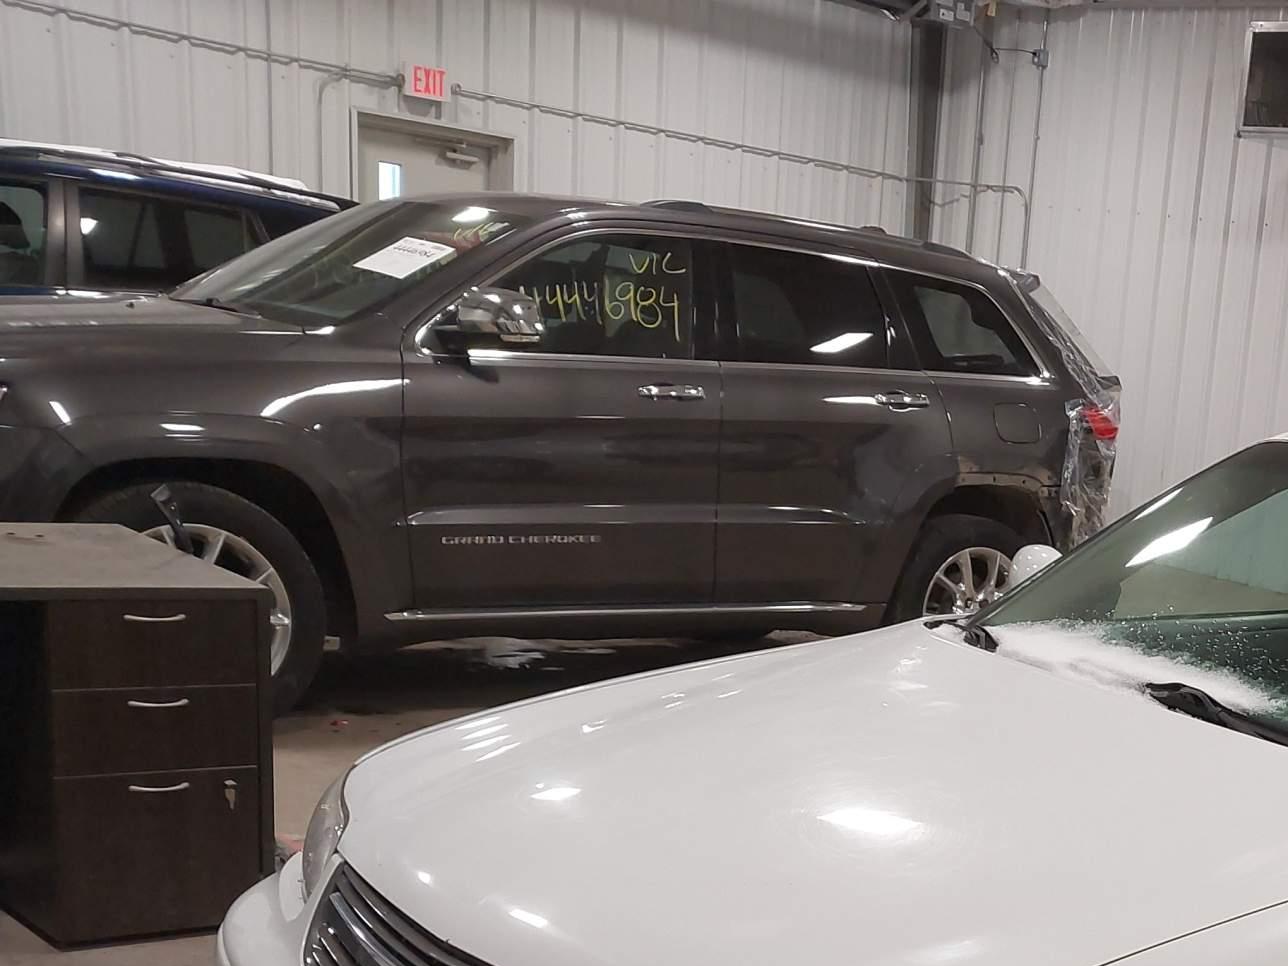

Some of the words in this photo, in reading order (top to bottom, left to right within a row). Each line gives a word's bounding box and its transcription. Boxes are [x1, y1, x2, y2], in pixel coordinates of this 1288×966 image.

[413, 66, 446, 97] EXIT
[441, 535, 504, 545] GRAND
[508, 535, 601, 544] CHEROKEE
